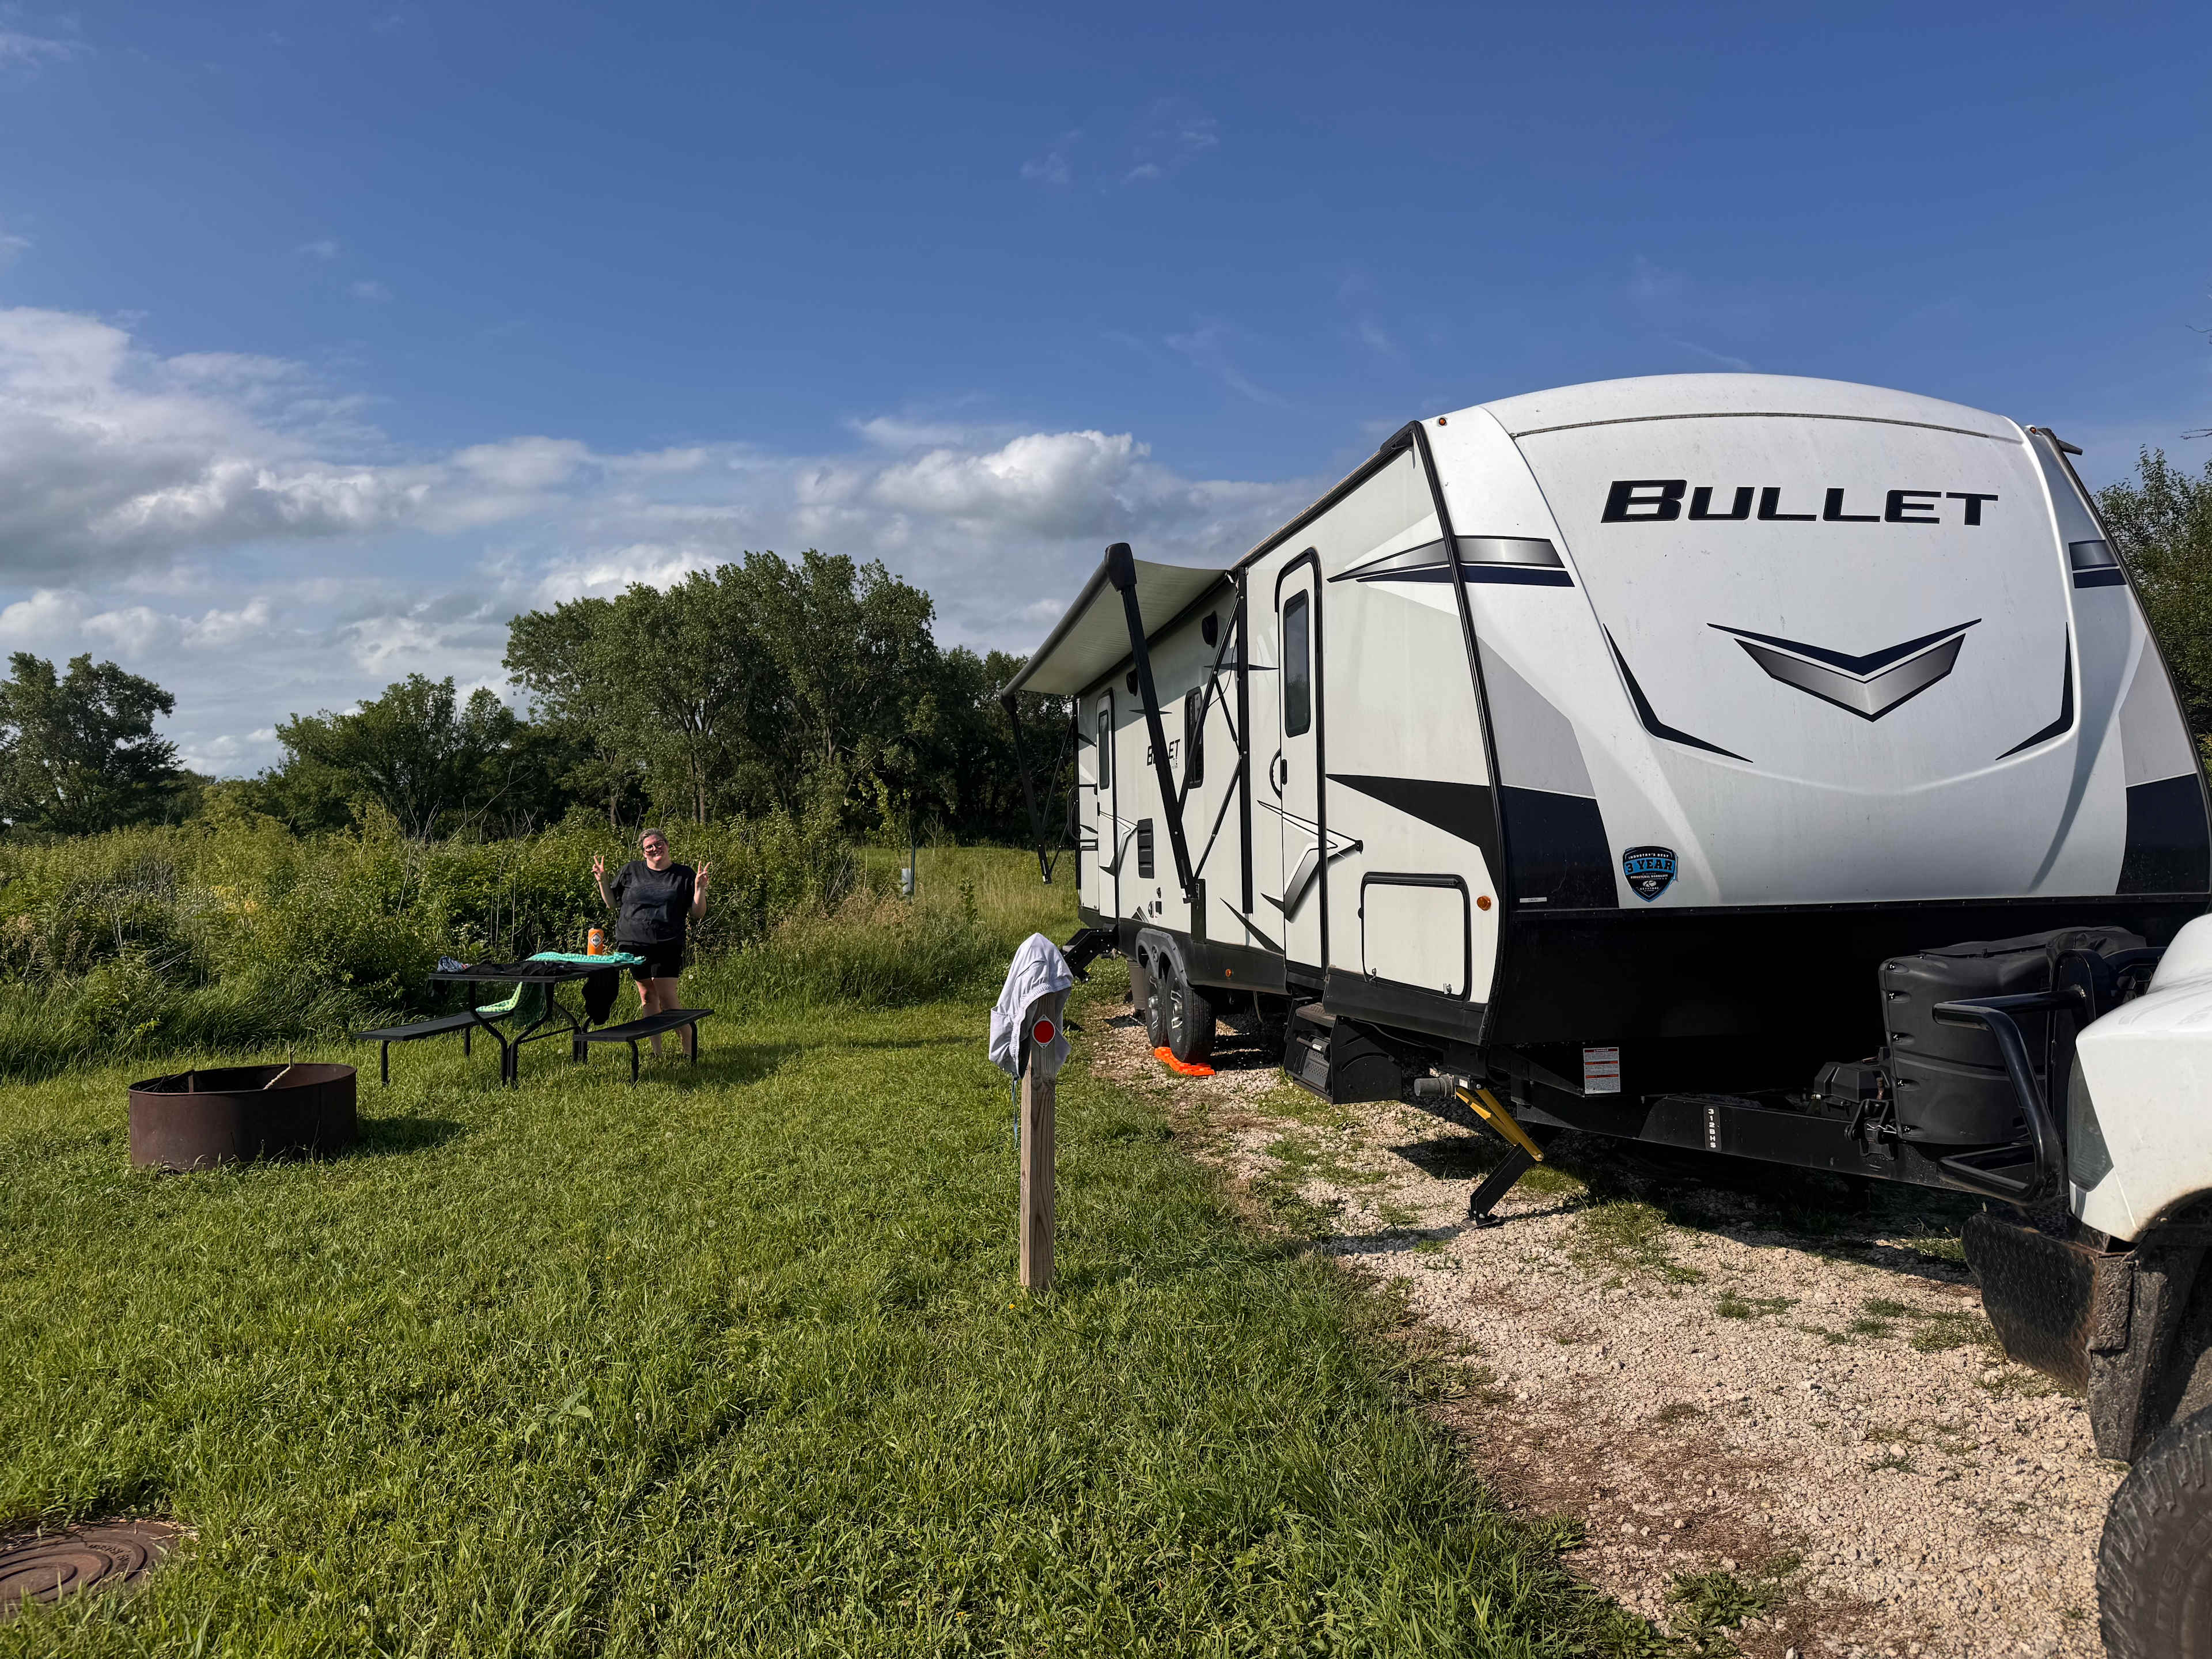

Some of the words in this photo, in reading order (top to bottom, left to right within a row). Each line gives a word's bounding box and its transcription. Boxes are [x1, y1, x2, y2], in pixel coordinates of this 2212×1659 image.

[1600, 479, 1998, 526] BULLET
[1147, 739, 1180, 766] BET
[1626, 862, 1634, 873] 3
[1637, 859, 1672, 871] YEAR
[1707, 1109, 1716, 1148] 312BHS
